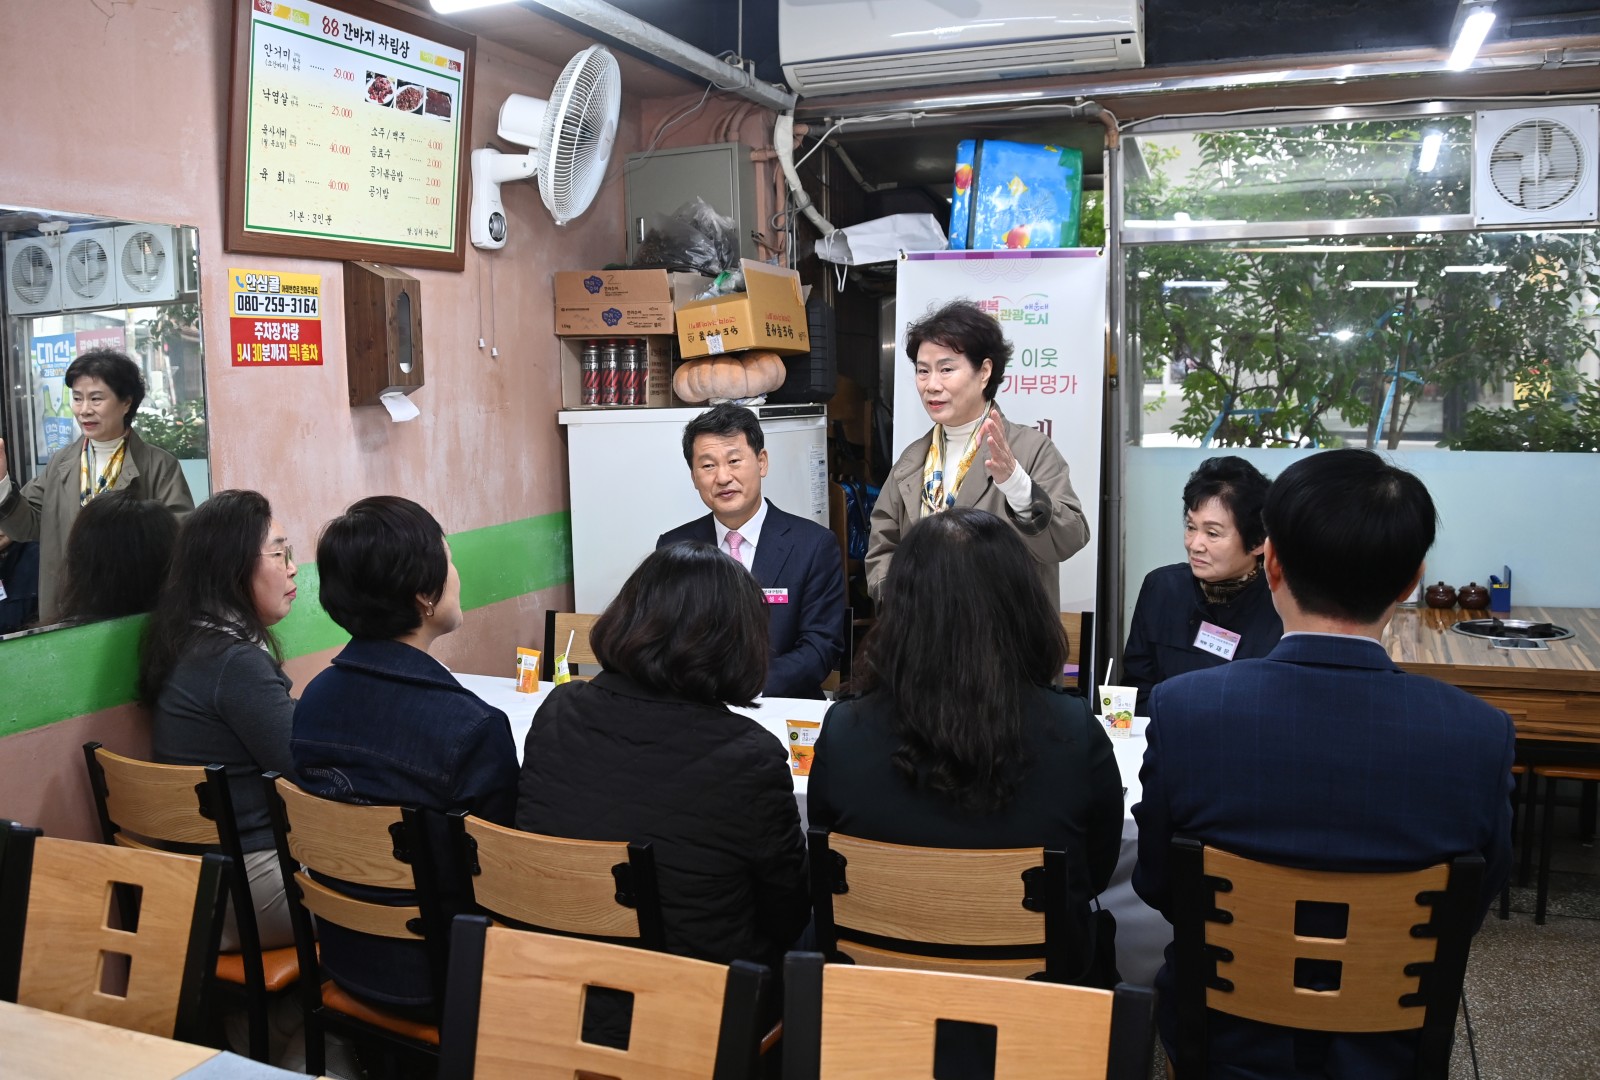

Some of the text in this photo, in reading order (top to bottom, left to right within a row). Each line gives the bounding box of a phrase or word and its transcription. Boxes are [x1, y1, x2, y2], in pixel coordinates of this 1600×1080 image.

[322, 16, 410, 59] 88 간바지 차림상
[264, 43, 291, 62] 안거미
[333, 68, 354, 81] 29.000
[262, 88, 288, 106] 낙엽살
[331, 105, 353, 119] 25.000
[261, 123, 287, 140] 육사시미
[329, 142, 351, 156] 40.000
[370, 145, 391, 160] 음료수
[427, 140, 443, 151] 4.000
[426, 158, 442, 169] 2.000
[369, 165, 404, 183] 공기볶음밥
[425, 177, 441, 188] 2.000
[328, 178, 350, 192] 40.000
[368, 185, 390, 200] 공기밥
[289, 210, 305, 223] 기본
[312, 213, 333, 226] 3인분
[245, 273, 281, 293] 안심콜
[237, 294, 317, 314] 080-259-3164
[254, 321, 300, 341] 주차장 차량
[36, 340, 71, 366] 대선
[237, 343, 319, 362] 9시 30분까지 꼭! 출차
[1021, 348, 1059, 368] 이웃
[1001, 374, 1078, 395] 기부명가
